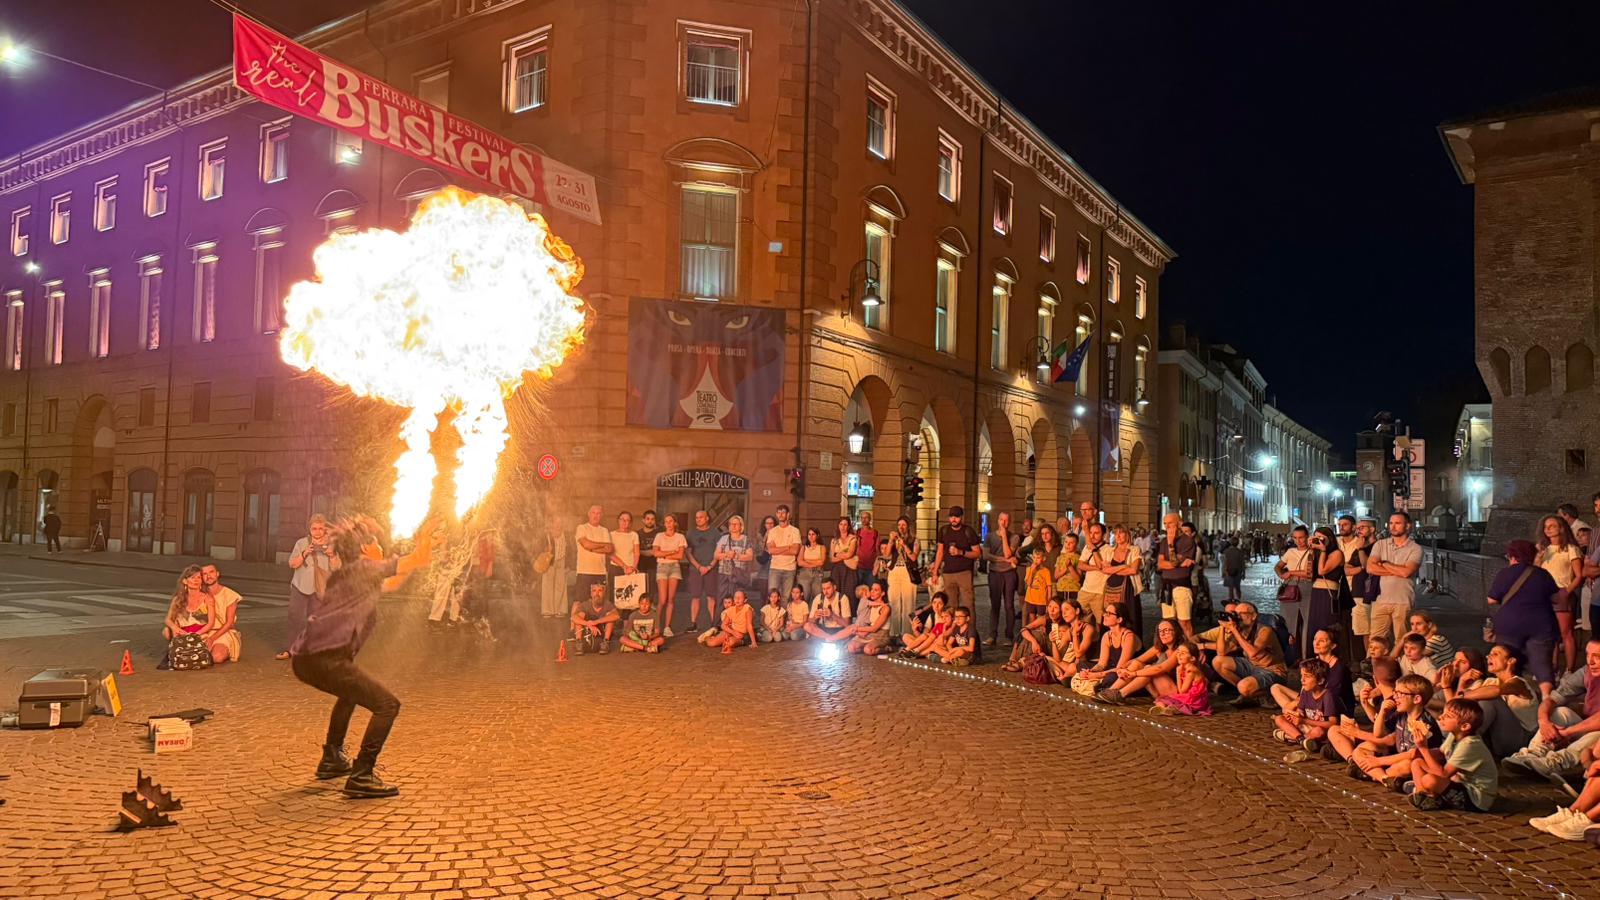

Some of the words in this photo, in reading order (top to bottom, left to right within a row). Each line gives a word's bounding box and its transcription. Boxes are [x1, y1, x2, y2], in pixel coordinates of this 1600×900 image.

[267, 41, 302, 74] the
[240, 60, 317, 107] real
[363, 79, 427, 118] FERRARA
[448, 118, 507, 152] FESTIVAL
[557, 194, 591, 212] AGOSTO
[697, 390, 718, 402] TEATRO
